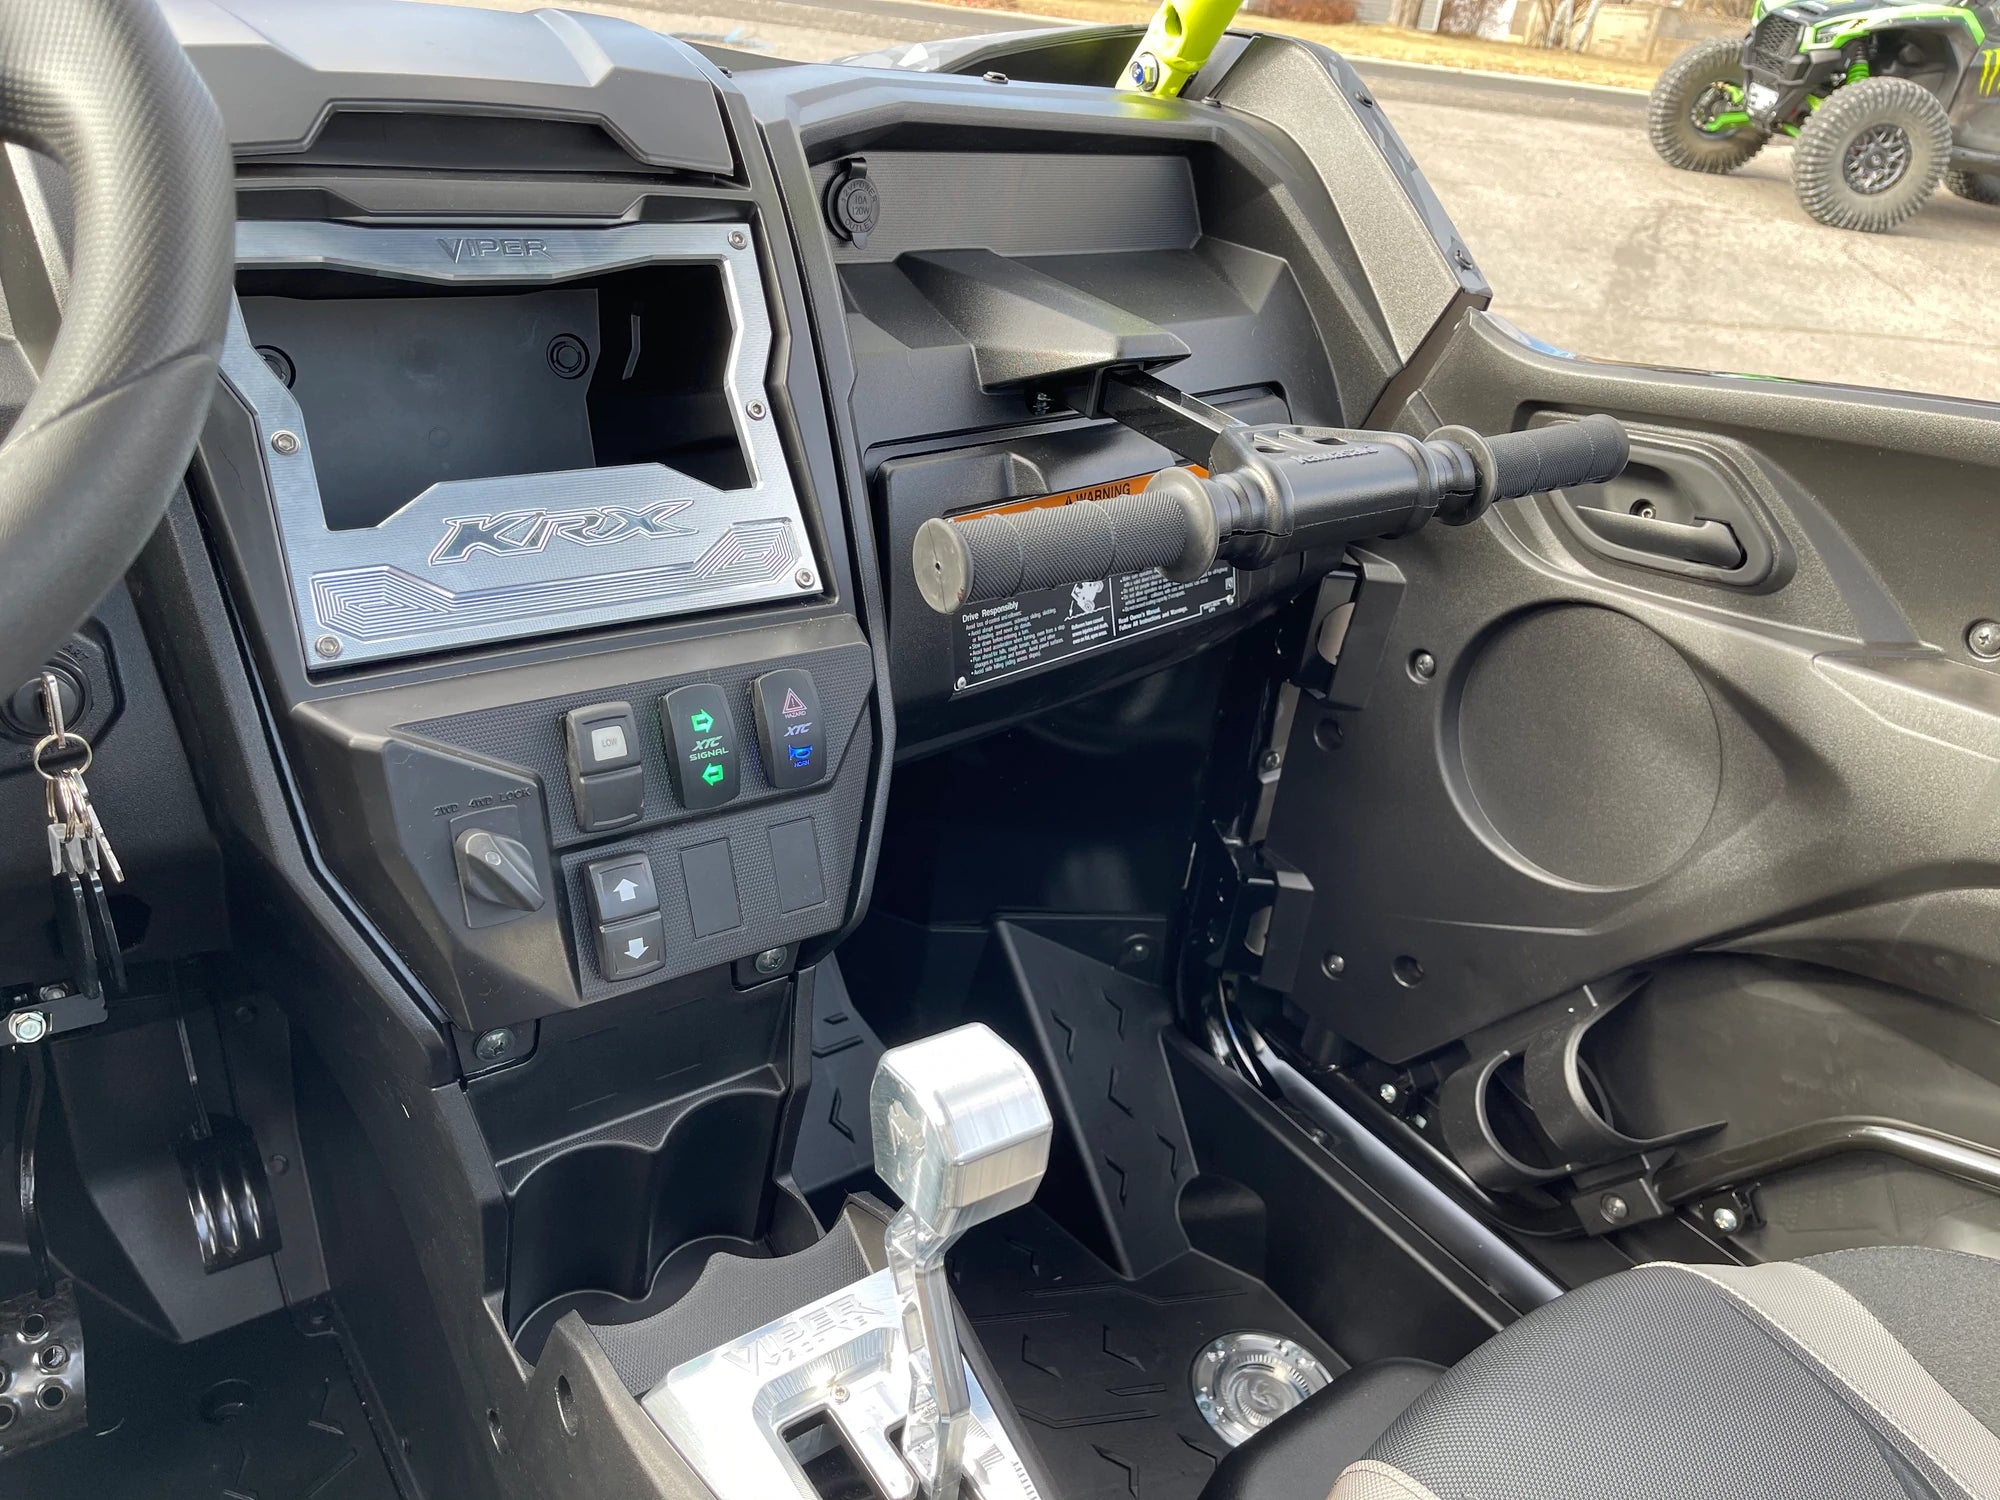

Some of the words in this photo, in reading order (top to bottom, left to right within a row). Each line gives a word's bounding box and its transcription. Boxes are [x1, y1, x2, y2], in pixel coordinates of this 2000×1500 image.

[844, 218, 873, 232] OUTLET
[436, 237, 552, 264] VIPER
[1076, 483, 1131, 502] WARNING
[428, 499, 700, 567] KRX
[962, 612, 980, 624] Drive
[982, 601, 1019, 618] Responsibly
[784, 710, 807, 720] HAZARD
[784, 722, 812, 738] XTC
[601, 737, 618, 748] LOW
[691, 736, 723, 752] XTC
[689, 747, 730, 762] SIGNAL
[794, 760, 810, 768] HORN
[432, 802, 459, 817] 2WD
[468, 795, 494, 808] 4WD
[499, 786, 532, 802] LOCK
[721, 1293, 886, 1376] VIPER
